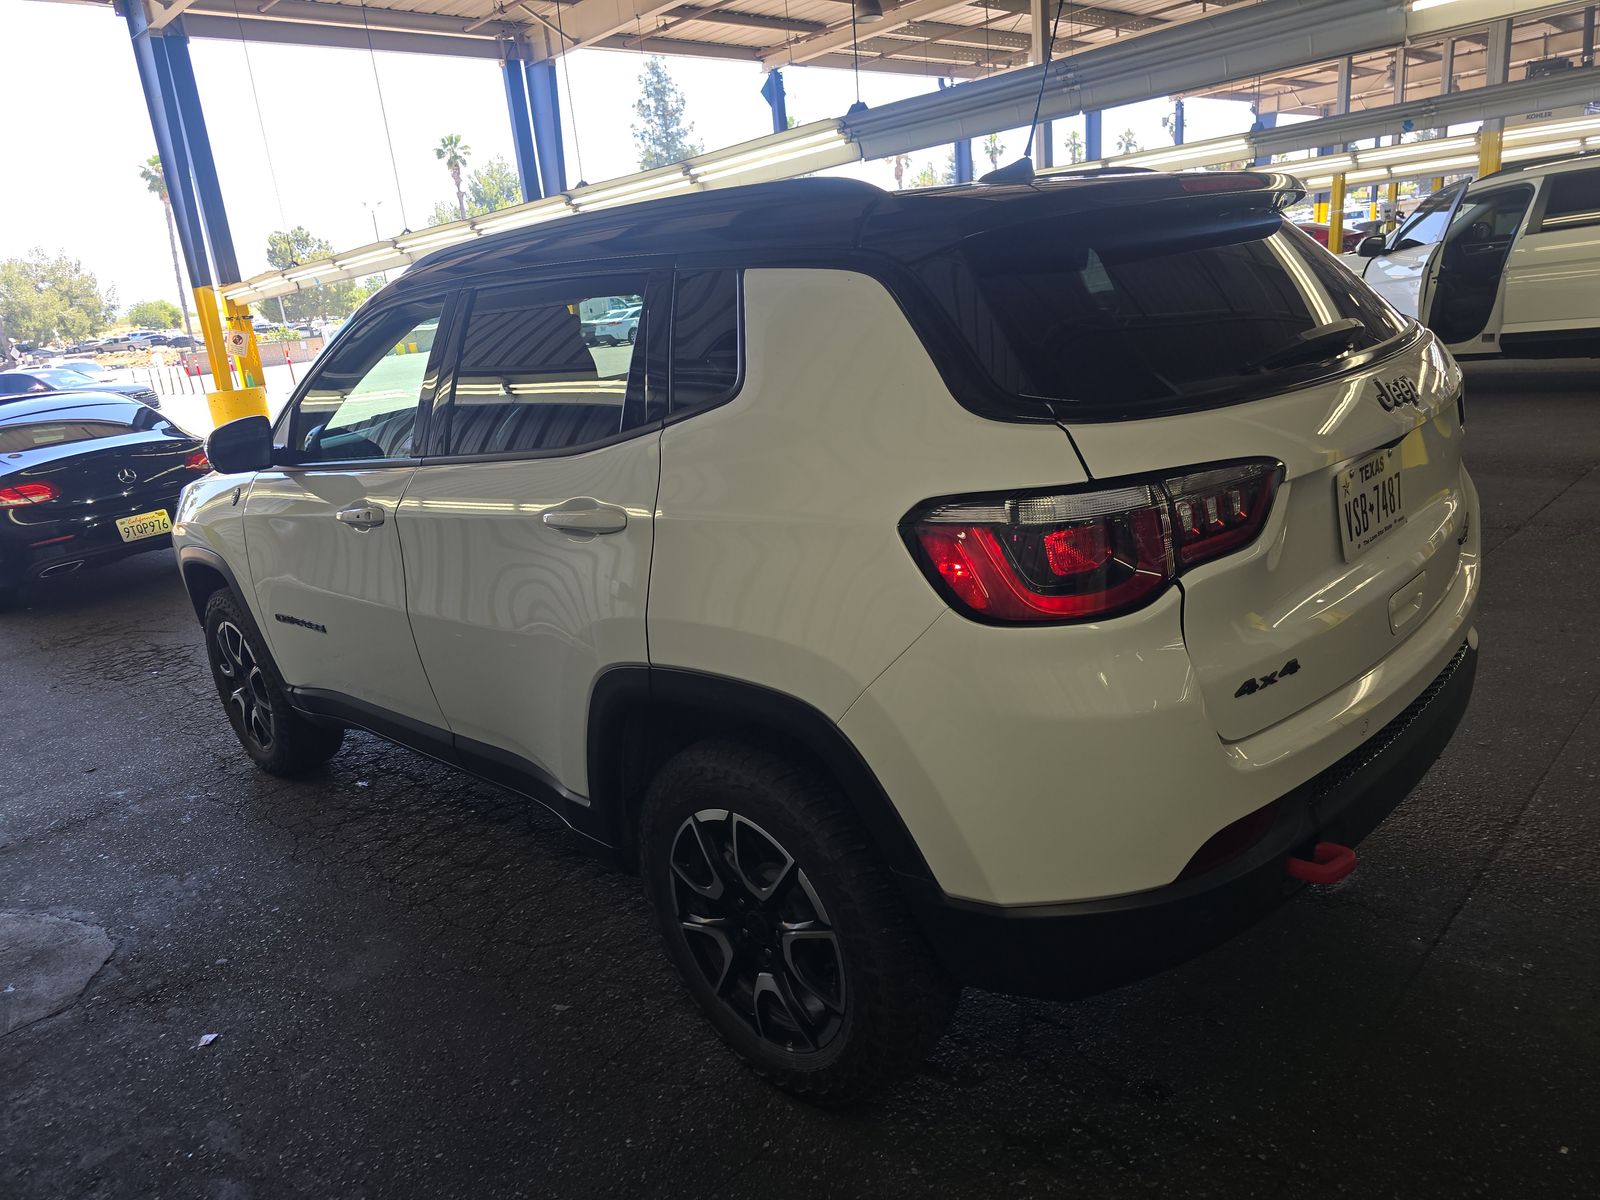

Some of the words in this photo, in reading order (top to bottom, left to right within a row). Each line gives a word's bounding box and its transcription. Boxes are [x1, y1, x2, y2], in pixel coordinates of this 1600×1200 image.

[1526, 111, 1552, 120] KOHLER
[1373, 376, 1420, 412] Jeep
[1359, 456, 1385, 484] TEXAS
[123, 518, 168, 538] 9TQP976
[1234, 658, 1301, 698] 4x4
